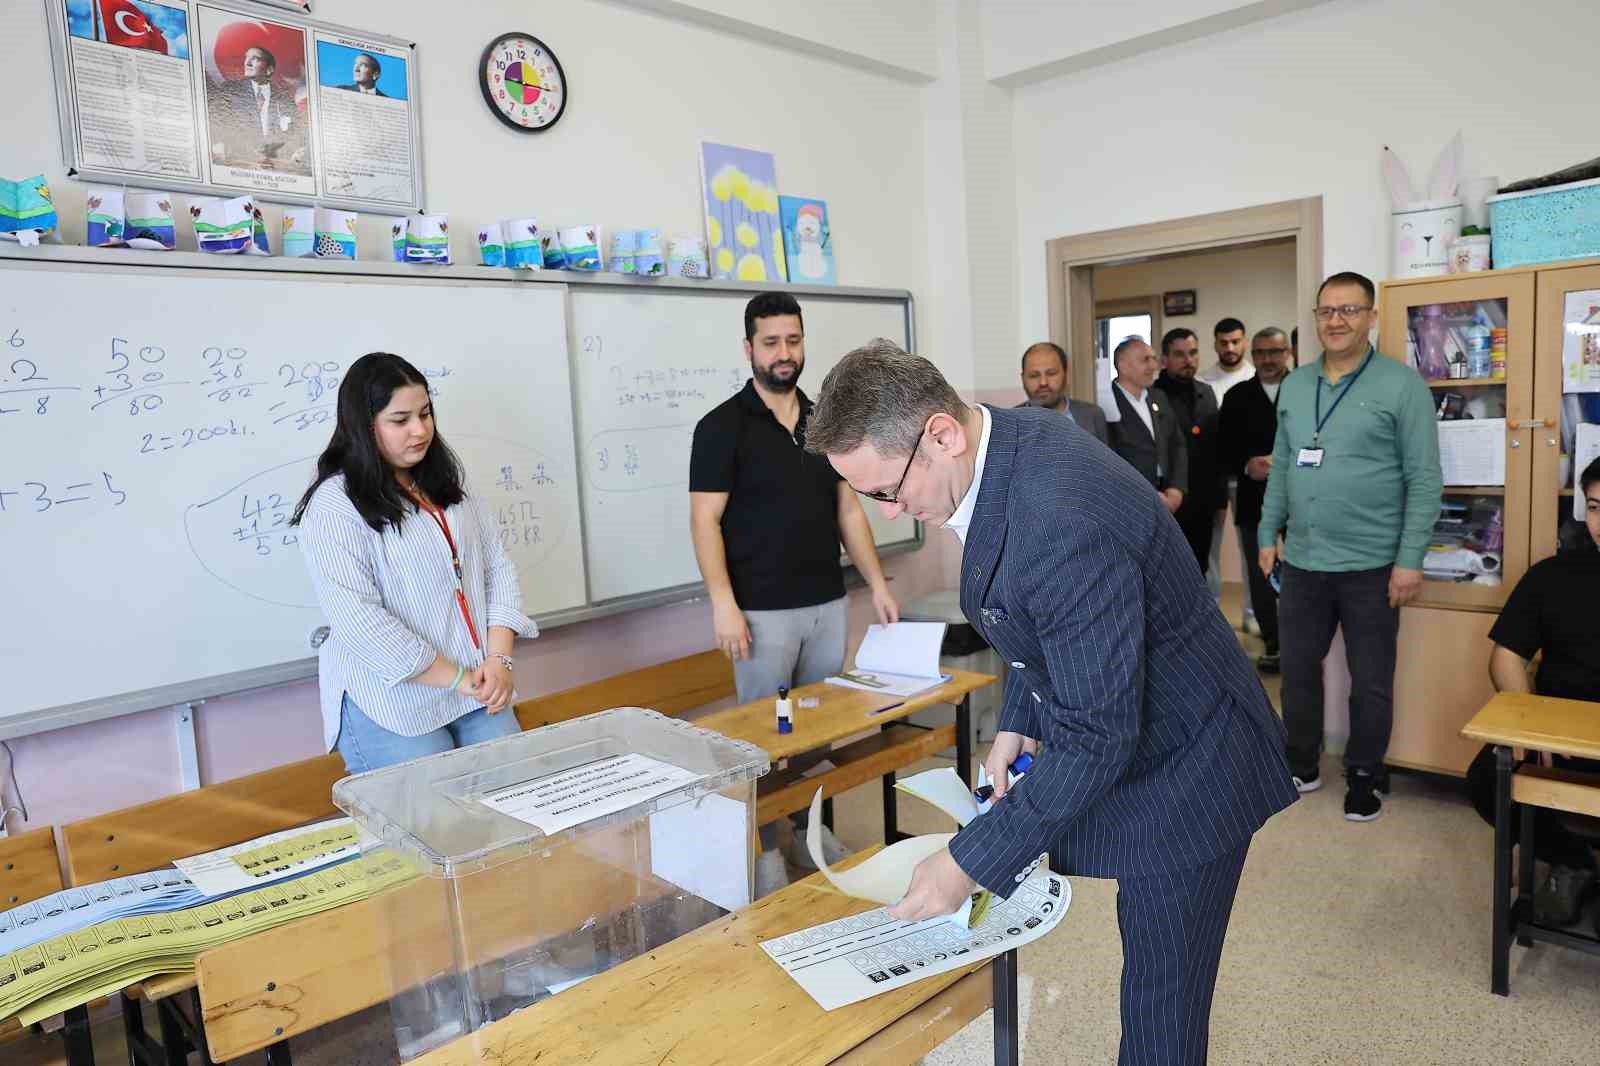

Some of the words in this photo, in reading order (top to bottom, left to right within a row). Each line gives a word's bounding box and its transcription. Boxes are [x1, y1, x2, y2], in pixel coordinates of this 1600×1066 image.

[505, 51, 512, 61] 11
[516, 49, 526, 60] 12
[496, 60, 506, 70] 10
[494, 74, 501, 83] 9
[509, 102, 515, 112] 7
[105, 336, 166, 376] 50
[128, 393, 164, 416] 80
